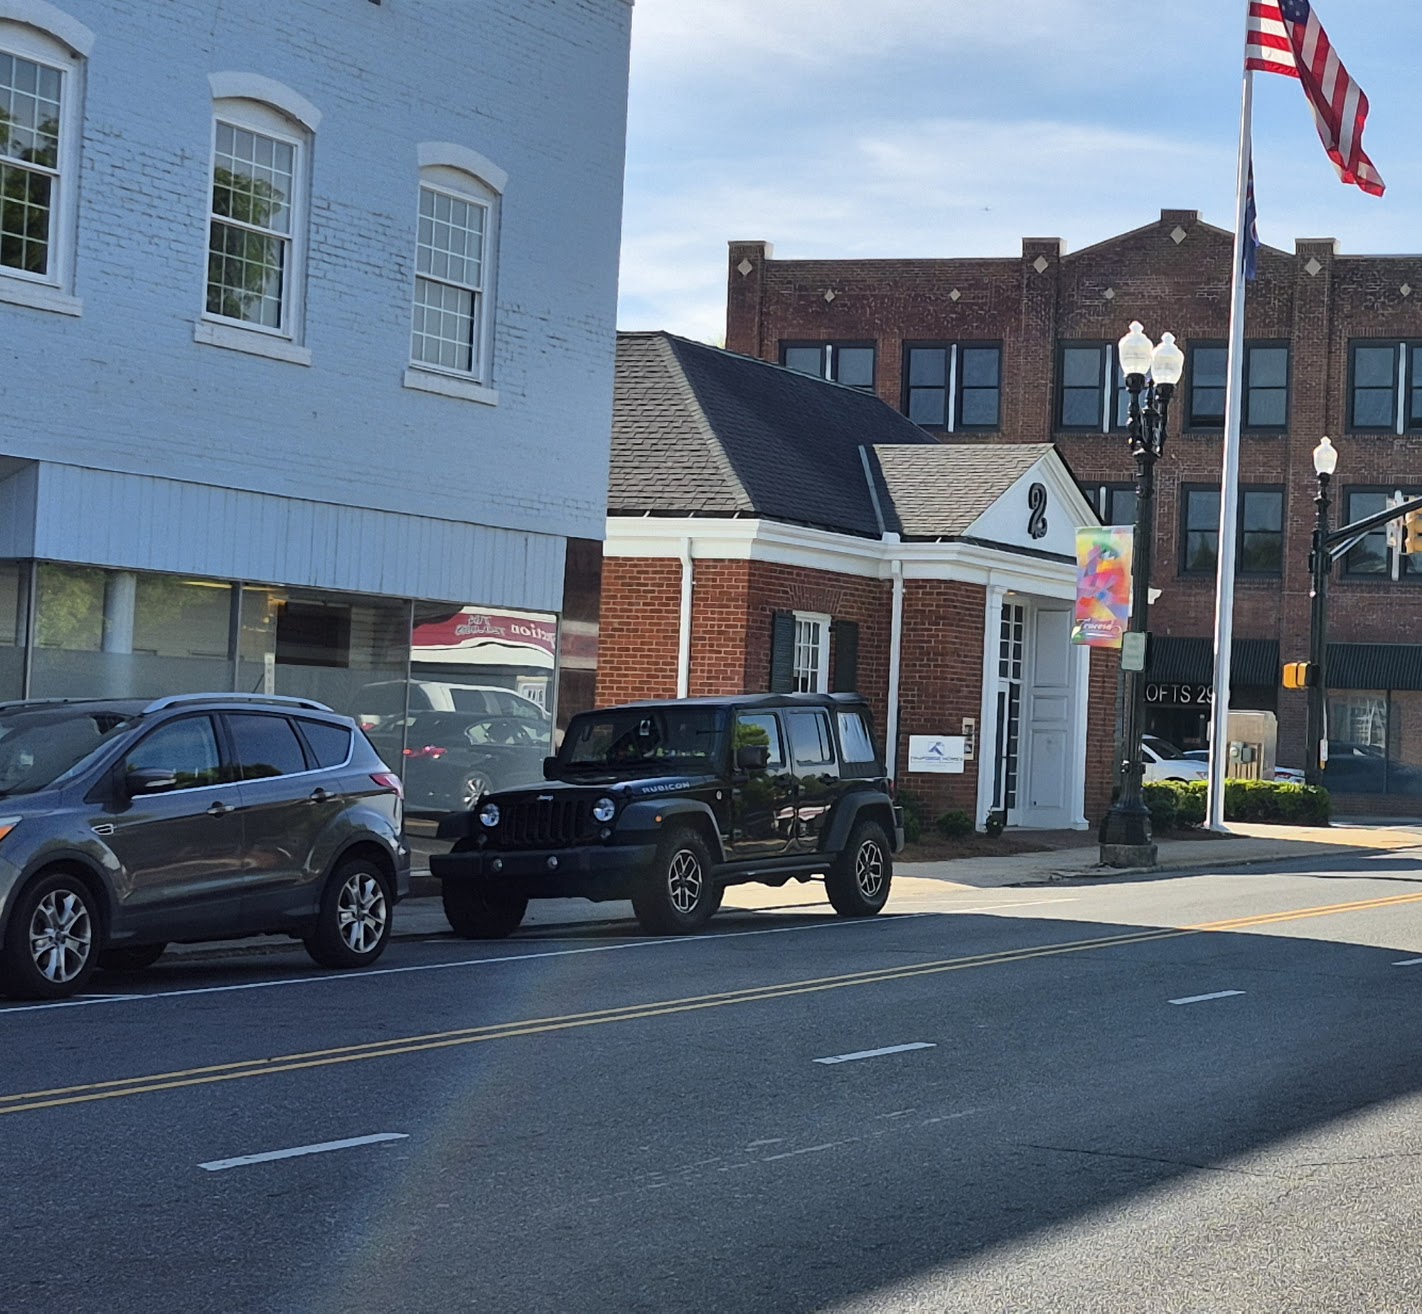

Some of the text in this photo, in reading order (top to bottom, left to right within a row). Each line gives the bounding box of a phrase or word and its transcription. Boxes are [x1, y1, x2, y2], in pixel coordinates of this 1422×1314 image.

[1028, 482, 1047, 540] 2
[1143, 683, 1191, 703] OFTS
[641, 781, 690, 793] RUBICON
